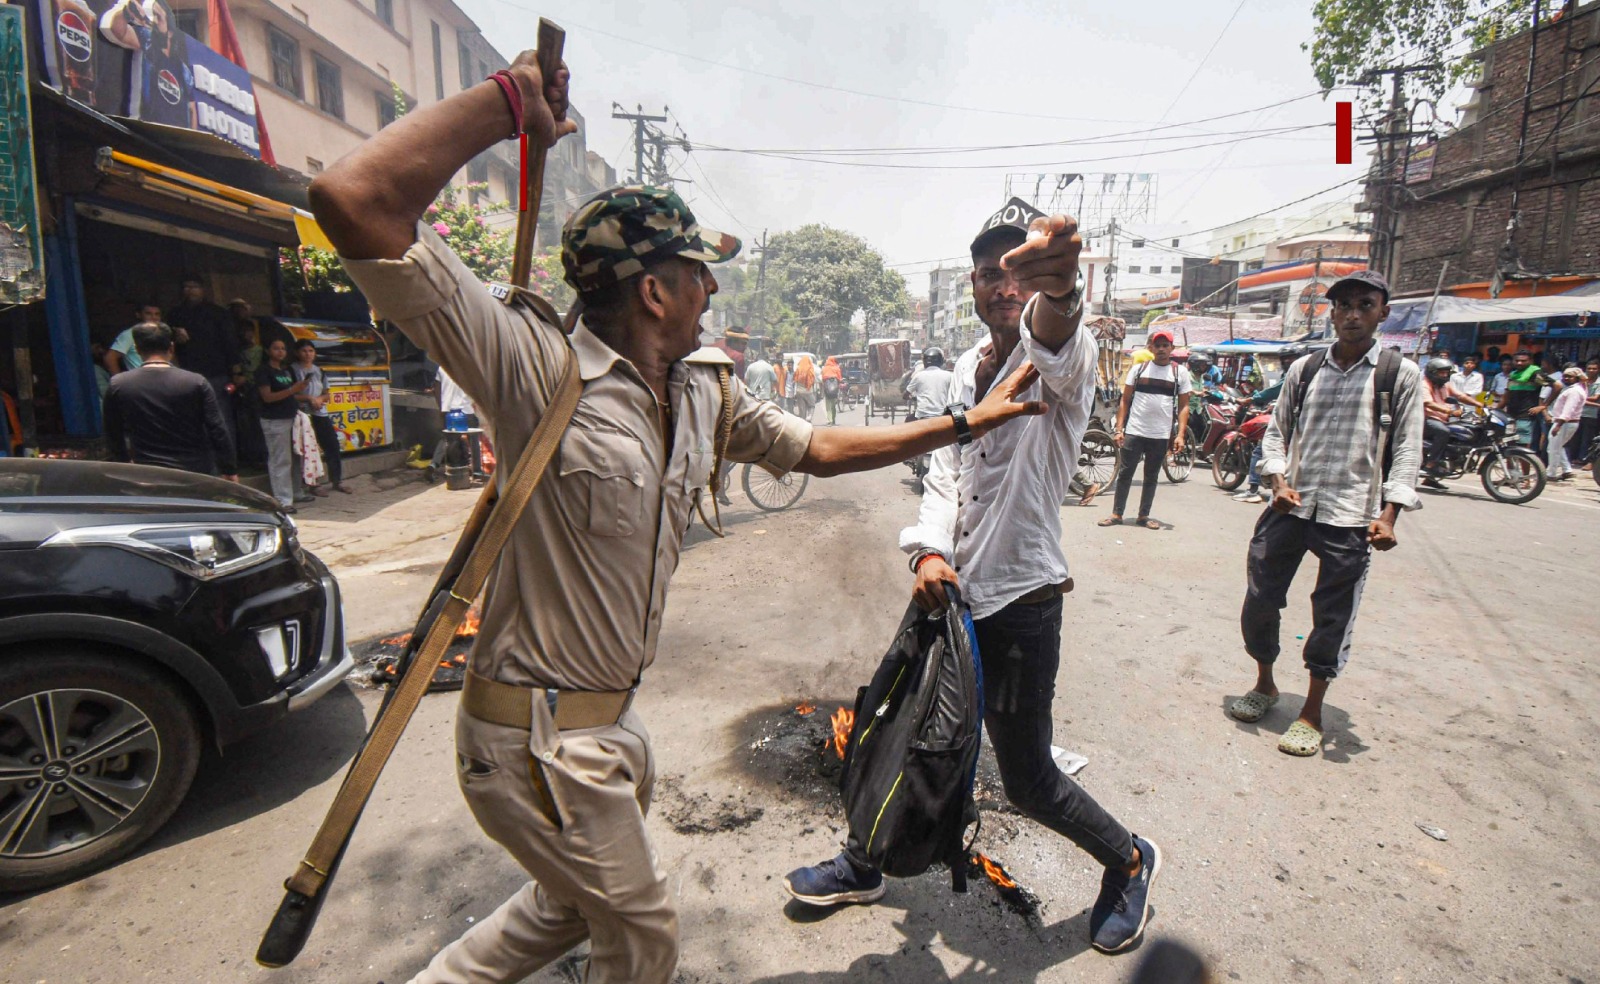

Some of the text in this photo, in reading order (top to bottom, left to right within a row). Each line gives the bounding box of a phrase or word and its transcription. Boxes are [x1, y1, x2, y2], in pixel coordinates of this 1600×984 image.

[59, 25, 90, 48] PEPSI
[197, 102, 260, 150] HOTEL
[988, 204, 1033, 230] BOY
[333, 392, 344, 403] का
[347, 406, 379, 423] होटल
